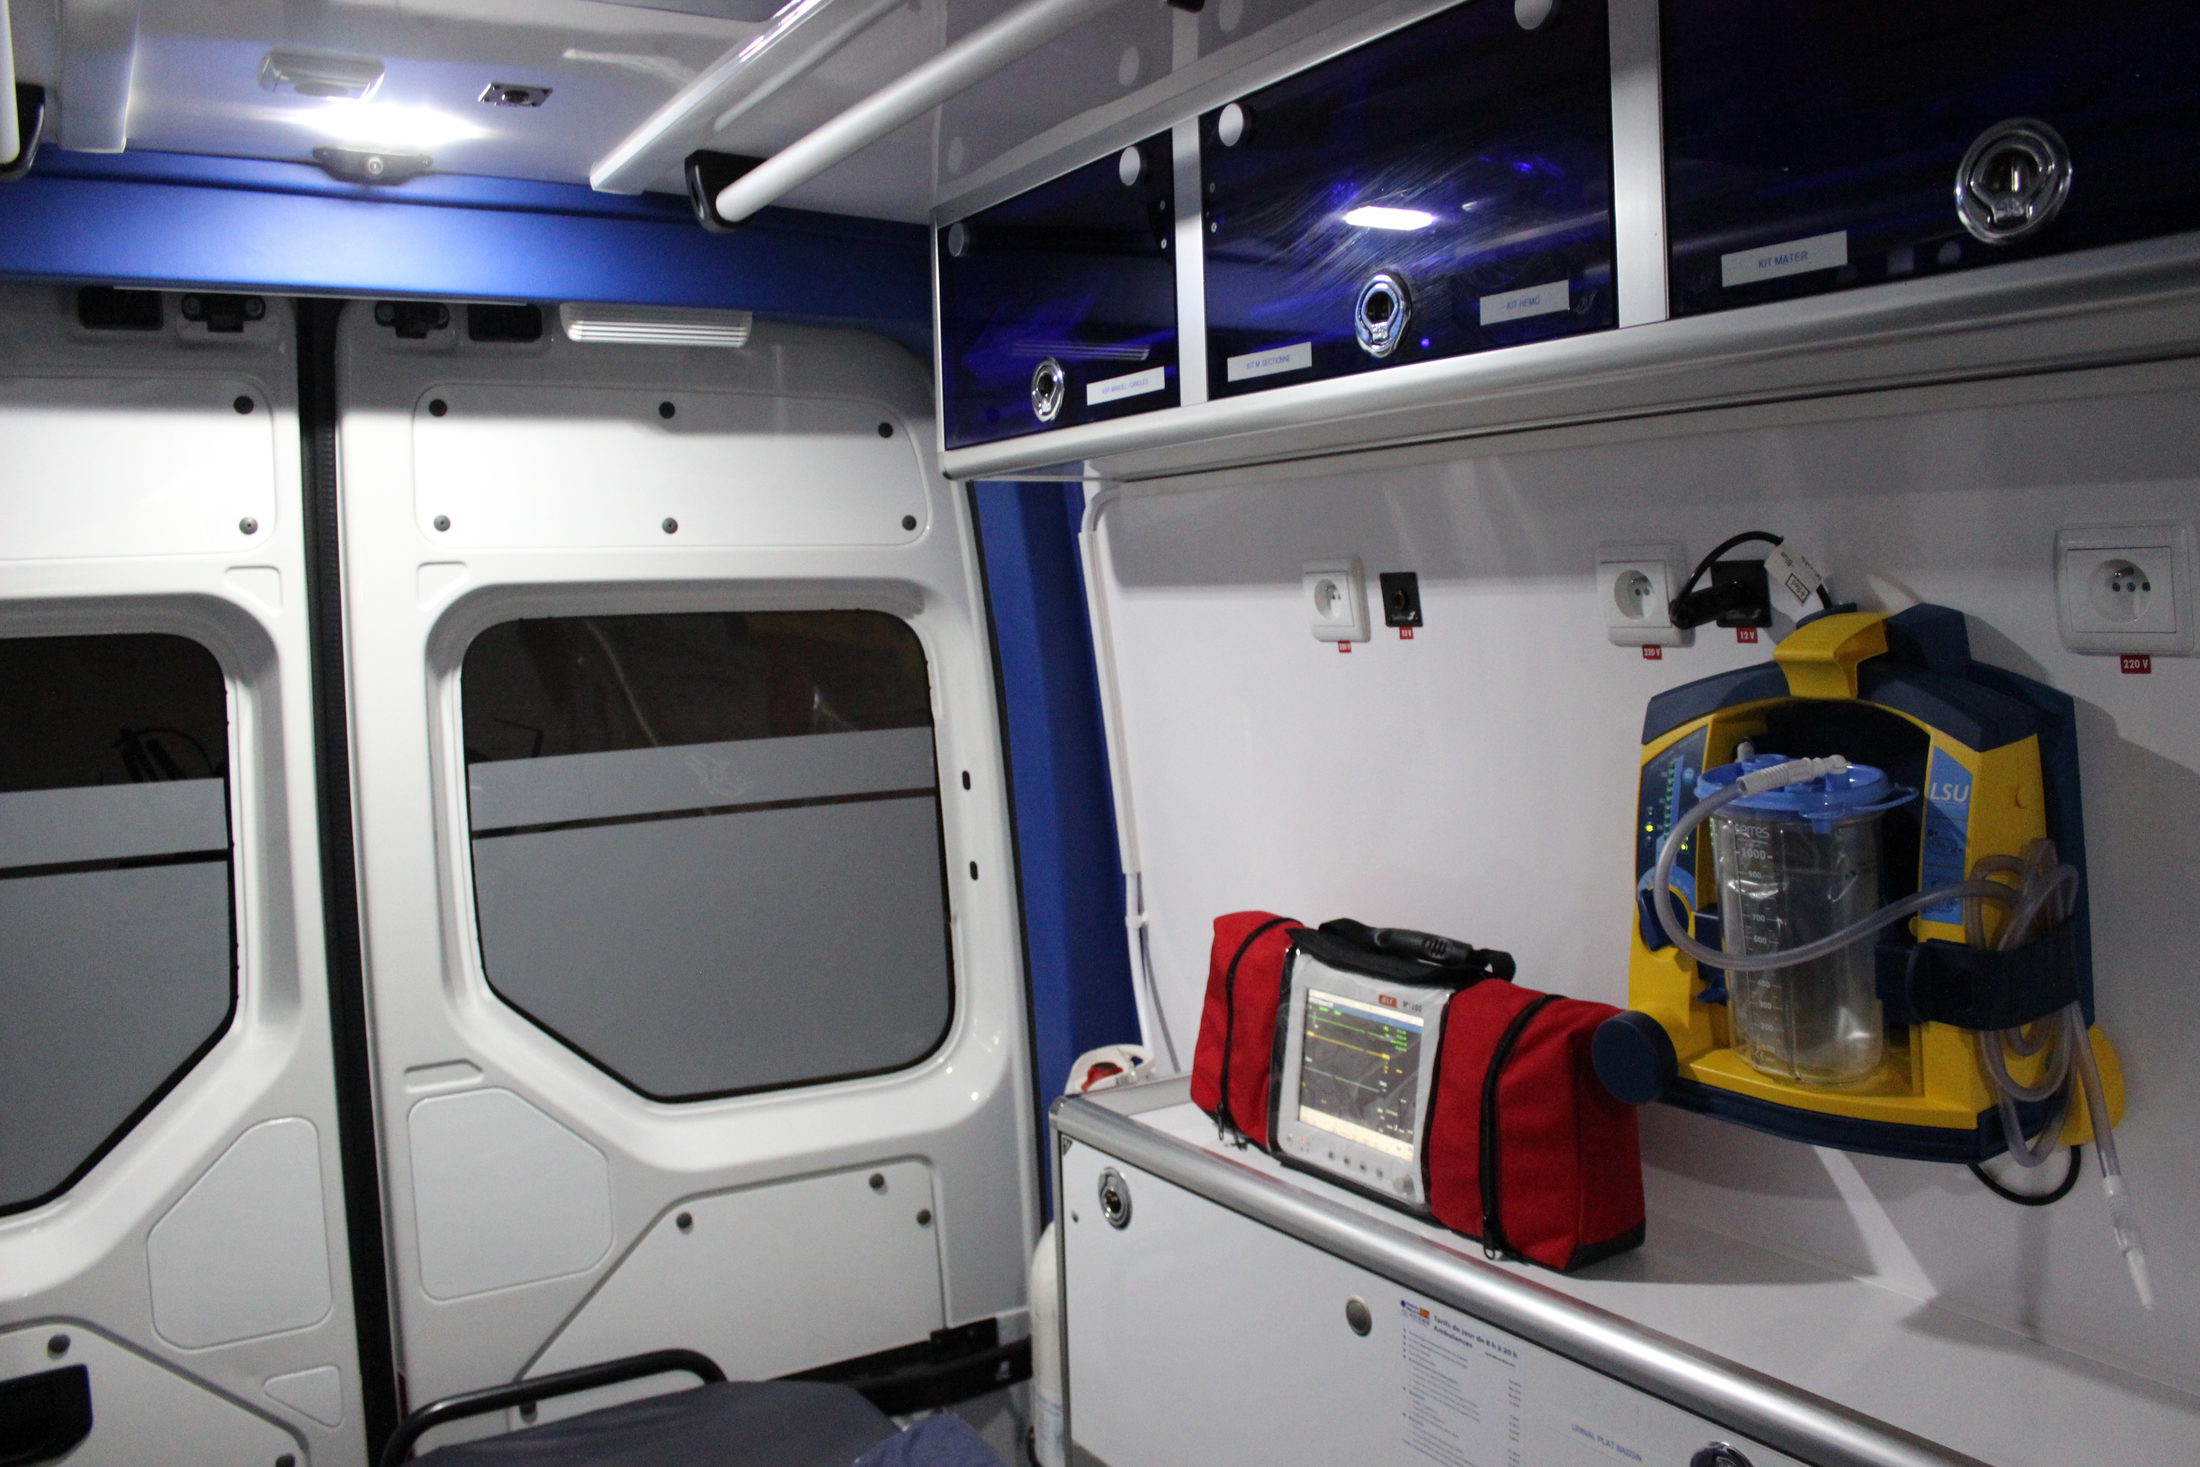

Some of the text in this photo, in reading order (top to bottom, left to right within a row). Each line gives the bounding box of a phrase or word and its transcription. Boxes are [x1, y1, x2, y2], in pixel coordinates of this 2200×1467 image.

[1758, 250, 1809, 269] KIT MATER
[1740, 631, 1755, 640] 12 V
[2123, 659, 2149, 669] 220 V
[1930, 782, 1970, 802] LSU
[1741, 848, 1766, 860] 1000
[1752, 913, 1766, 922] 700
[1753, 935, 1768, 945] 600
